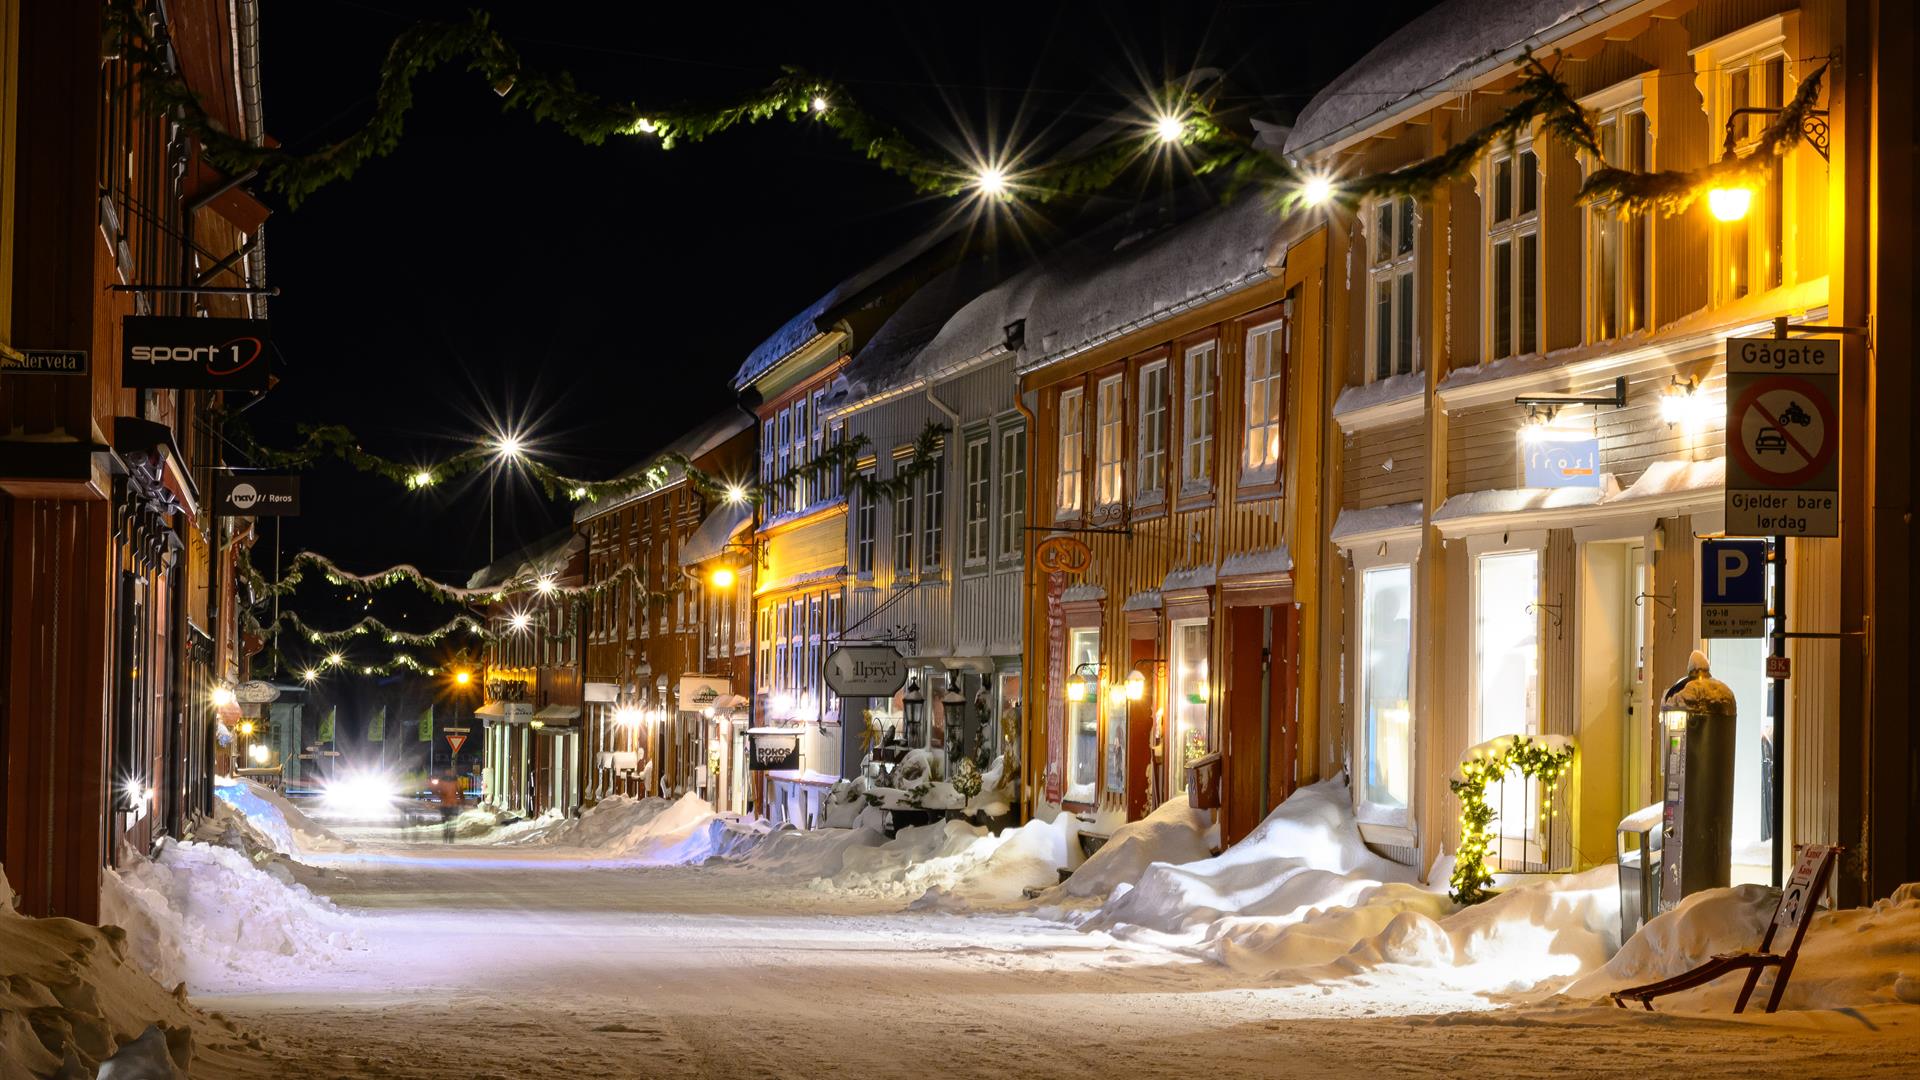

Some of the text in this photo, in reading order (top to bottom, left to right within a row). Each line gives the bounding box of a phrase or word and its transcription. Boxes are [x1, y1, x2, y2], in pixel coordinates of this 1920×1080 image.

[131, 345, 239, 365] sport 1
[1741, 343, 1825, 369] Gågate
[269, 494, 292, 503] Røros
[1732, 494, 1832, 511] Gjelder bare
[1757, 514, 1807, 532] lørdag
[1717, 549, 1749, 596] P
